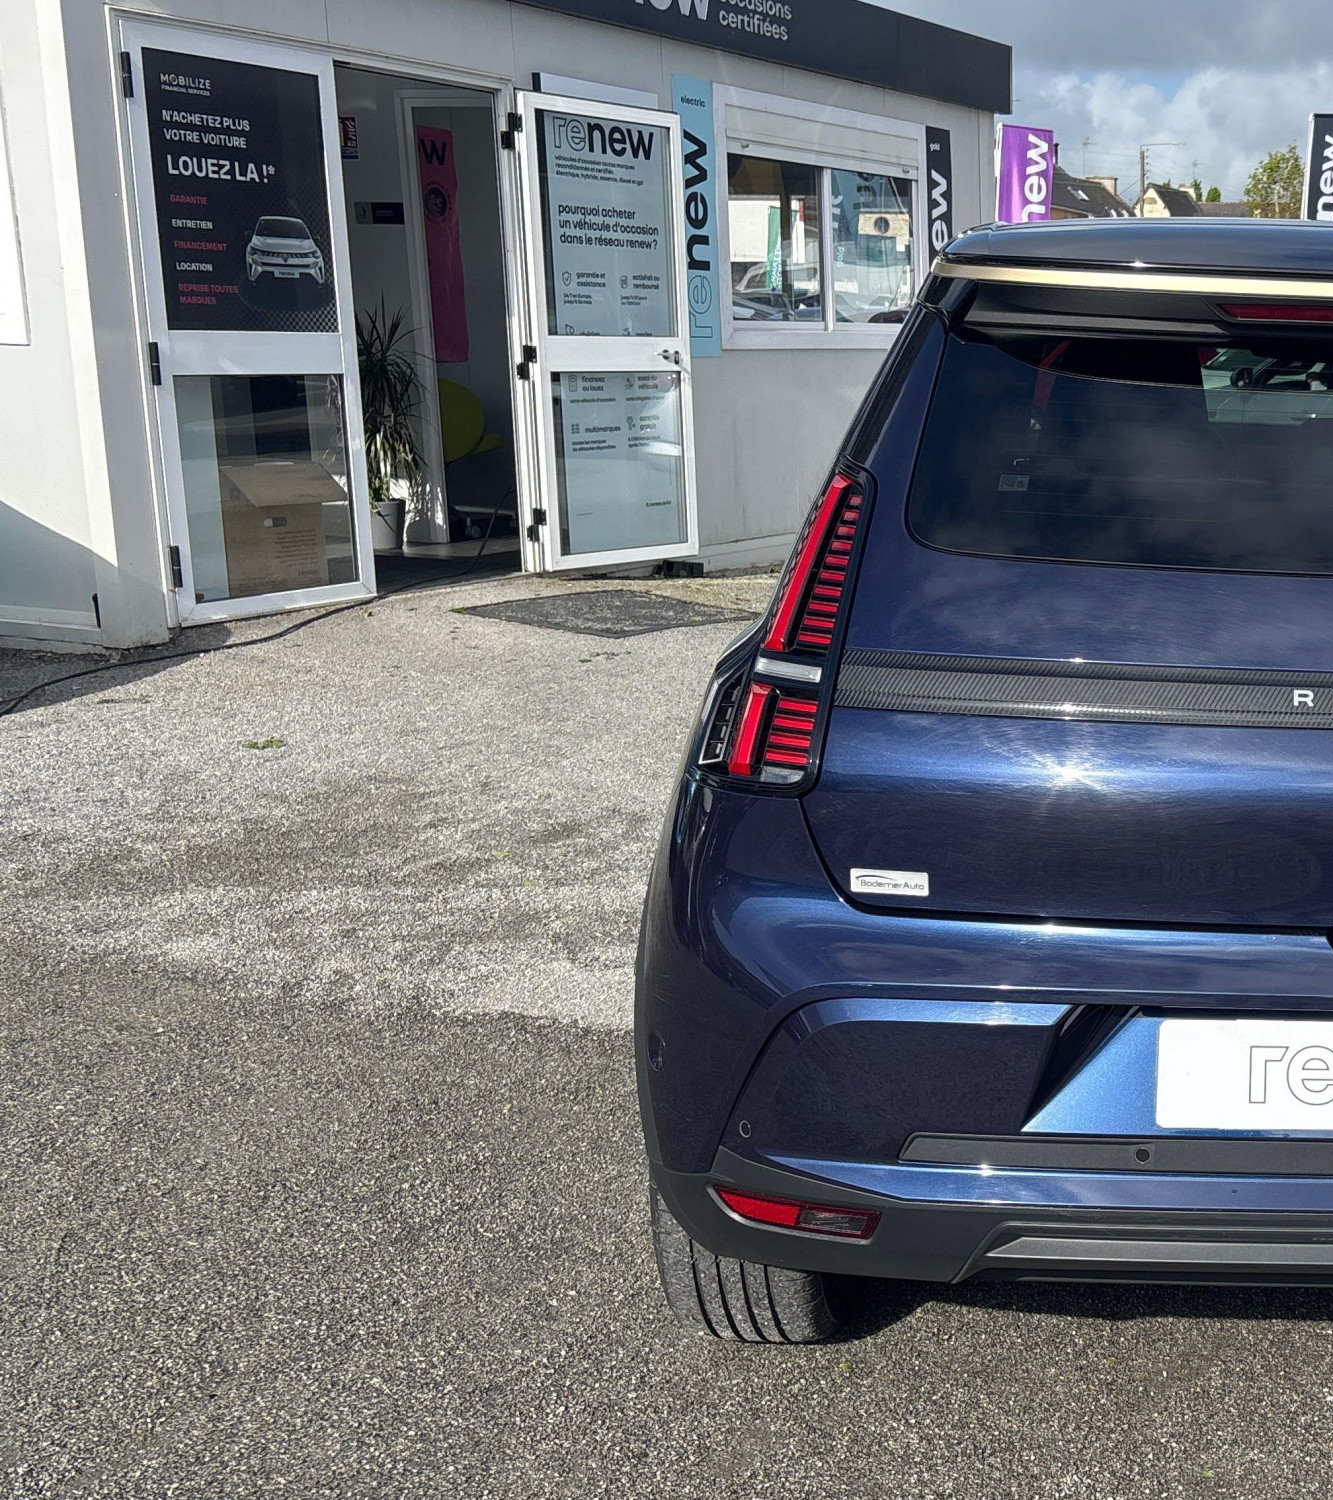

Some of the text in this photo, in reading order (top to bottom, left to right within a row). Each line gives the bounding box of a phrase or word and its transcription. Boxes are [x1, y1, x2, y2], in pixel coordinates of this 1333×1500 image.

[720, 0, 792, 20] casions
[719, 10, 789, 41] certifiées
[160, 73, 212, 90] MOBILIZE
[188, 88, 210, 97] SERVICES
[680, 95, 706, 108] electric
[162, 109, 250, 131] N'ACHETEZ PLUS
[163, 128, 247, 148] VOTRE VOITURE
[553, 116, 654, 161] renew
[166, 154, 231, 180] LOUEZ
[234, 161, 259, 183] LA
[170, 194, 208, 205] GARANTIE
[558, 204, 636, 220] pourquoi acheter
[171, 219, 213, 230] ENTRETIEN
[559, 217, 659, 236] un véhicule d'occasion
[560, 232, 583, 244] dans
[585, 233, 594, 245] le
[595, 234, 625, 248] réseau
[683, 129, 713, 339] renew
[174, 241, 228, 251] FINANCEMENT
[176, 262, 213, 272] LOCATION
[576, 272, 599, 280] garantie
[178, 284, 239, 294] REPRISE TOUTES
[179, 296, 217, 305] MARQUES
[585, 425, 621, 434] multimarques
